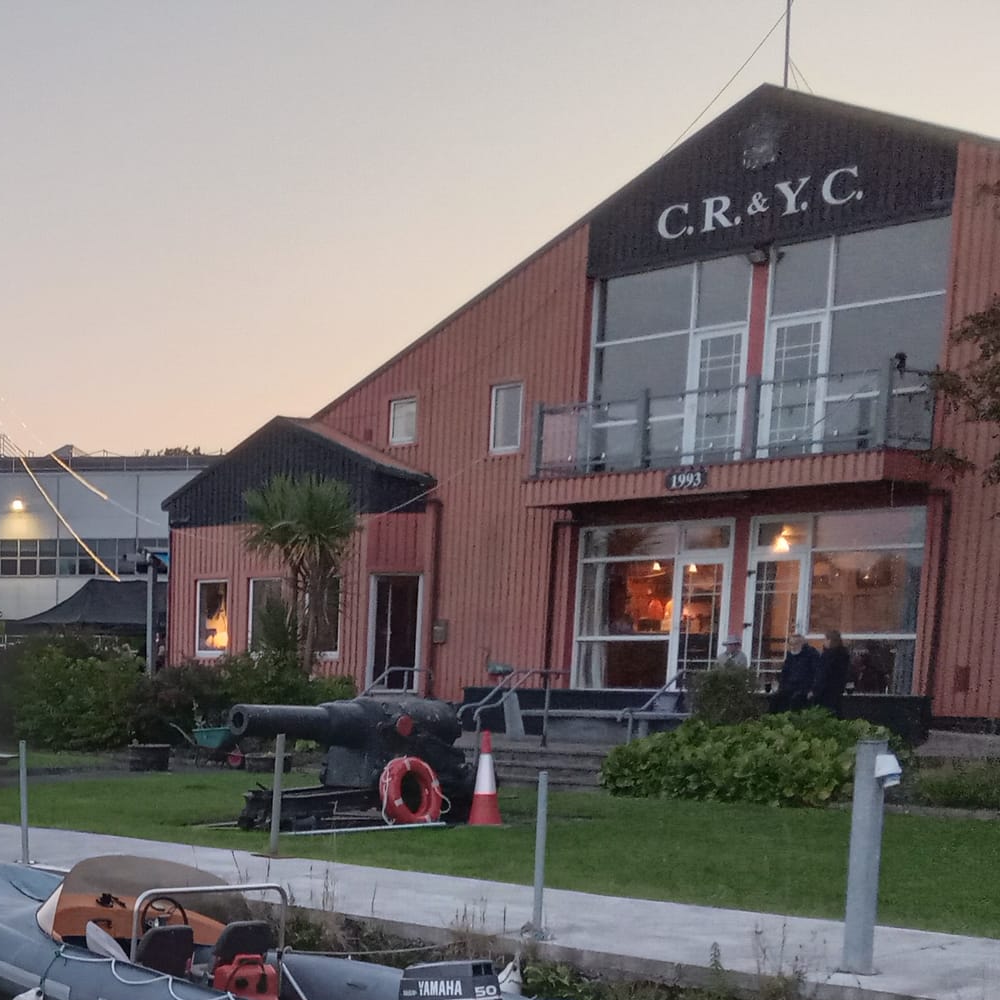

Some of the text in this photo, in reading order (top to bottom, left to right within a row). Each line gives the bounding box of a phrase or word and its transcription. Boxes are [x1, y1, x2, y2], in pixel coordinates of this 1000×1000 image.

[670, 471, 702, 489] 1993
[418, 980, 463, 996] YAMAHA
[475, 985, 497, 997] 50
